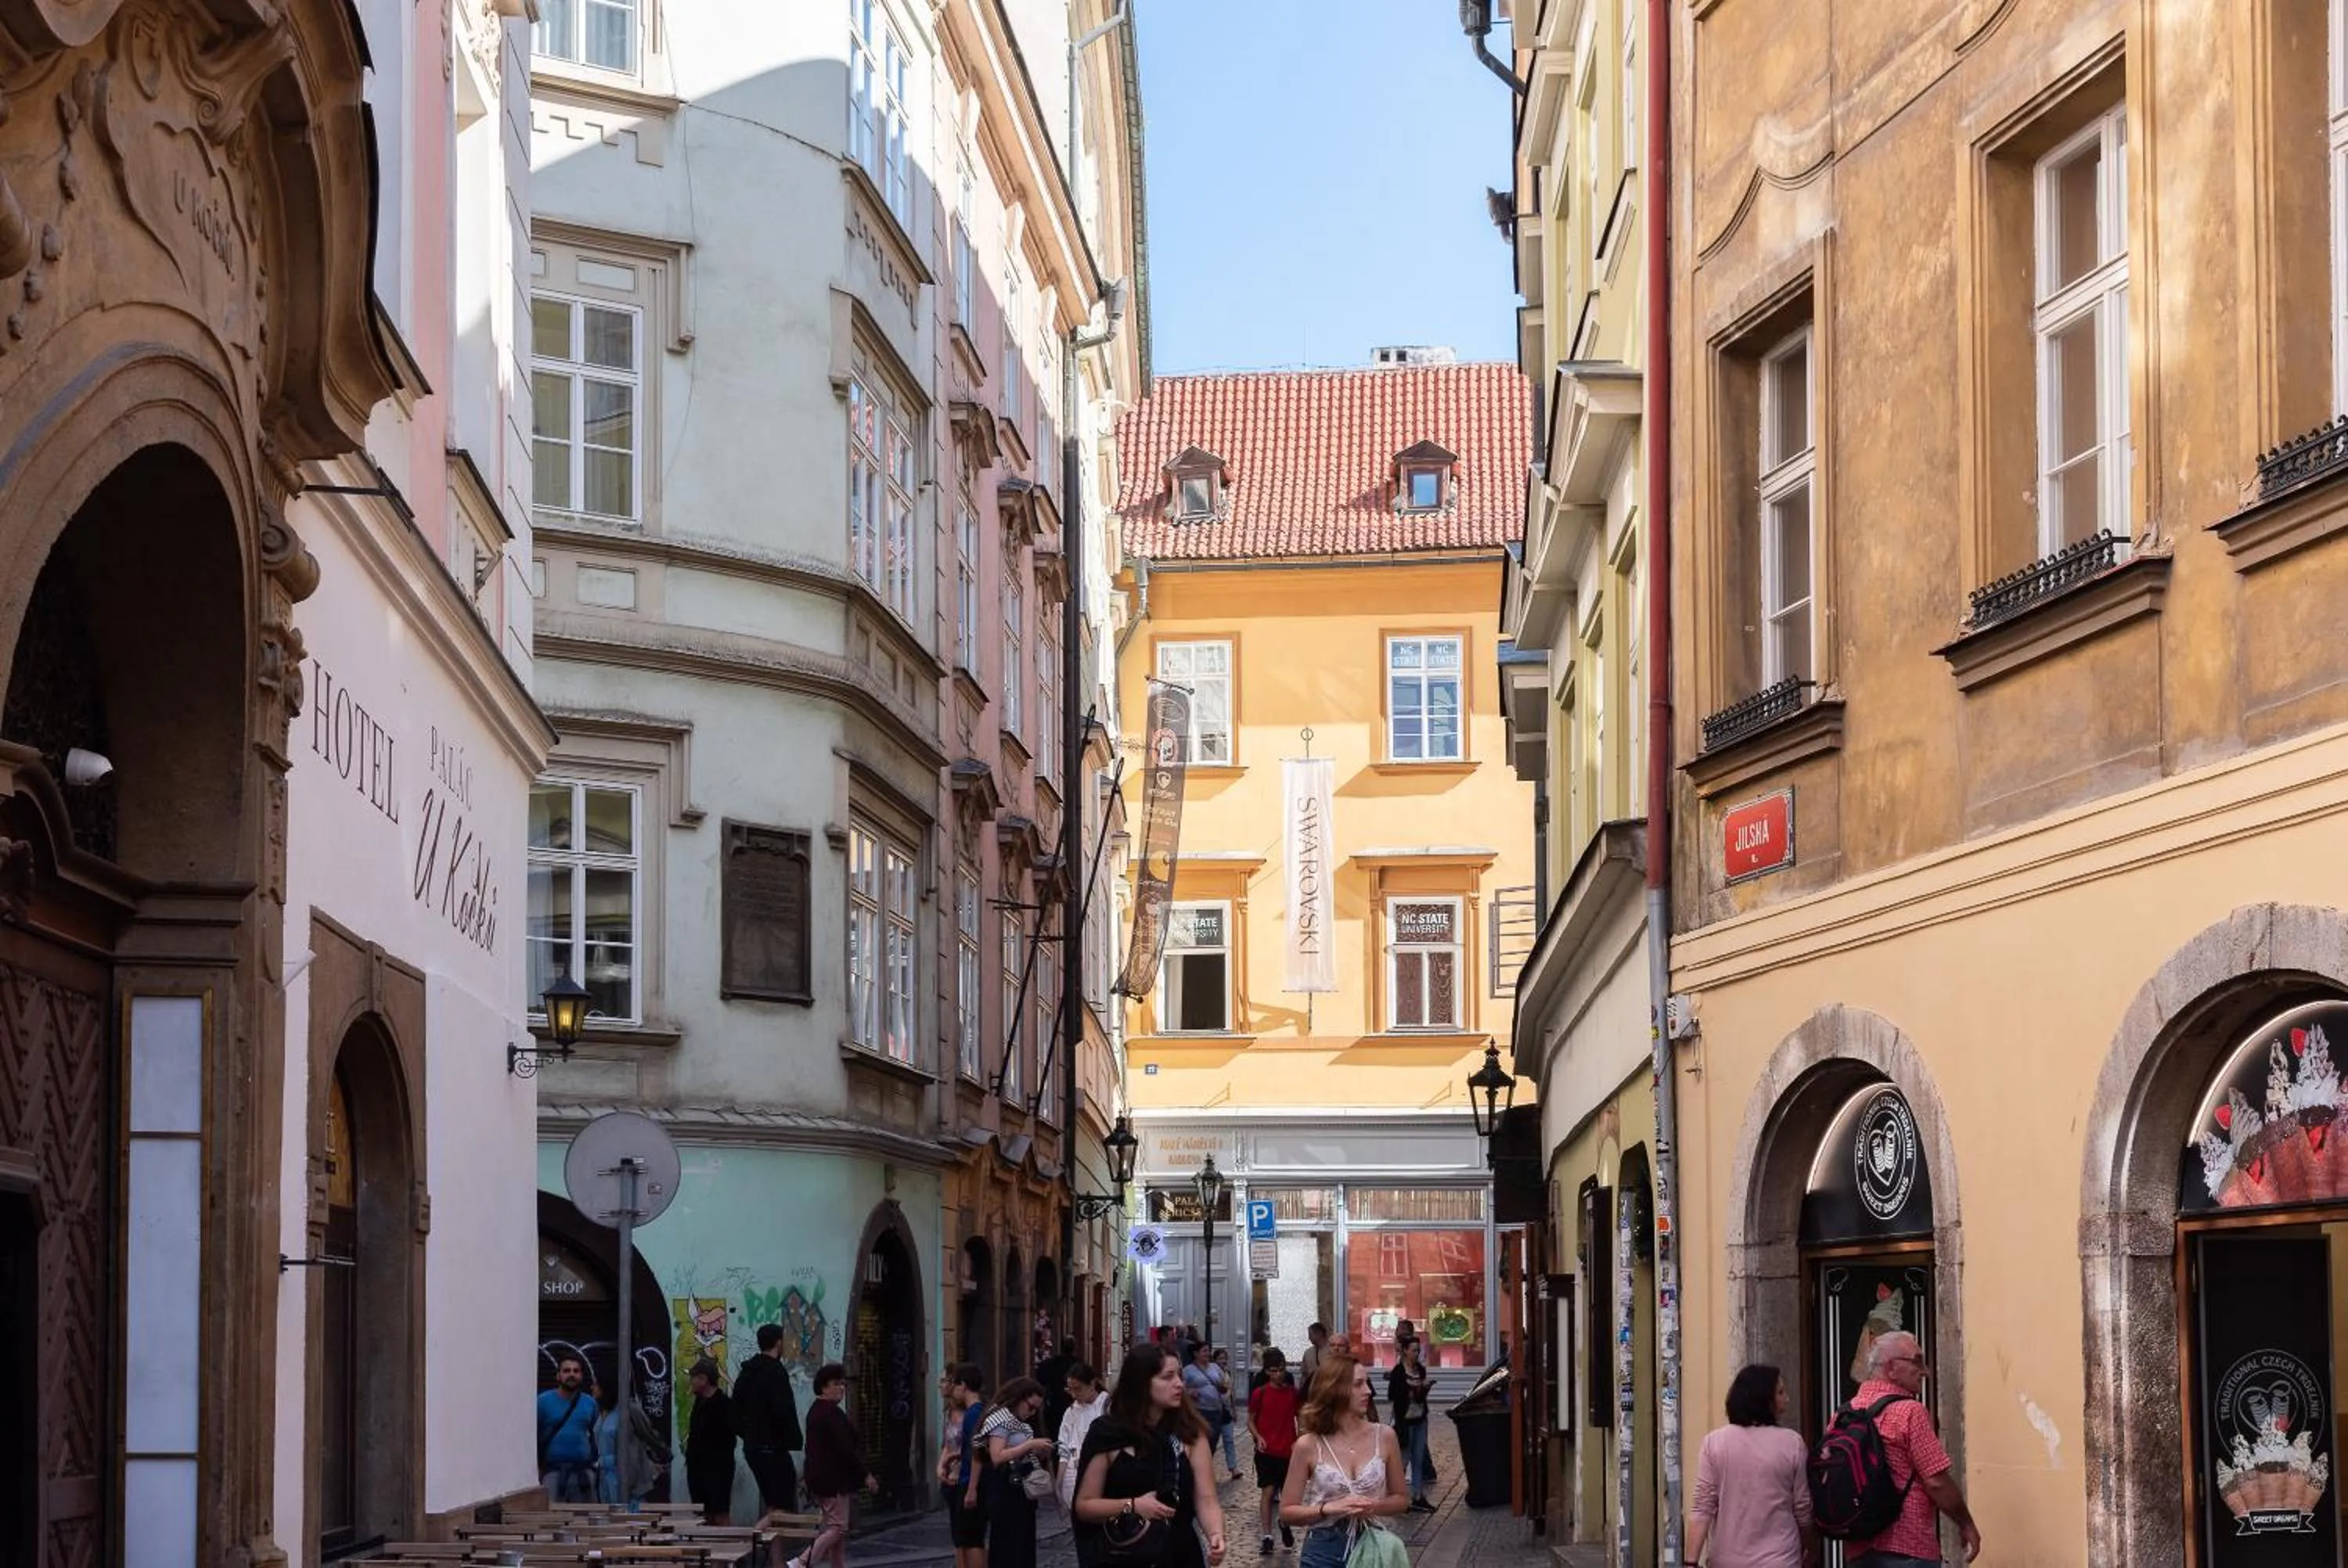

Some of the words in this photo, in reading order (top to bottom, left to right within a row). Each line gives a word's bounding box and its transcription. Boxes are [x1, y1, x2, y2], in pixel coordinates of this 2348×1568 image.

[173, 169, 185, 214] U
[1400, 646, 1413, 655] NC
[1436, 645, 1449, 654] NC
[312, 658, 398, 825] HOTEL
[430, 726, 474, 812] PALÁC
[414, 788, 446, 908] U
[1297, 797, 1320, 955] SWAROVSKI
[1401, 924, 1451, 934] UNIVERSITY
[1402, 914, 1416, 924] NC
[1418, 913, 1449, 924] STATE
[1252, 1205, 1268, 1228] P
[543, 1282, 584, 1294] SHOP
[2220, 1358, 2260, 1420] TRADITIONAL
[2261, 1355, 2296, 1373] CZECH
[2253, 1515, 2271, 1523] SWEET
